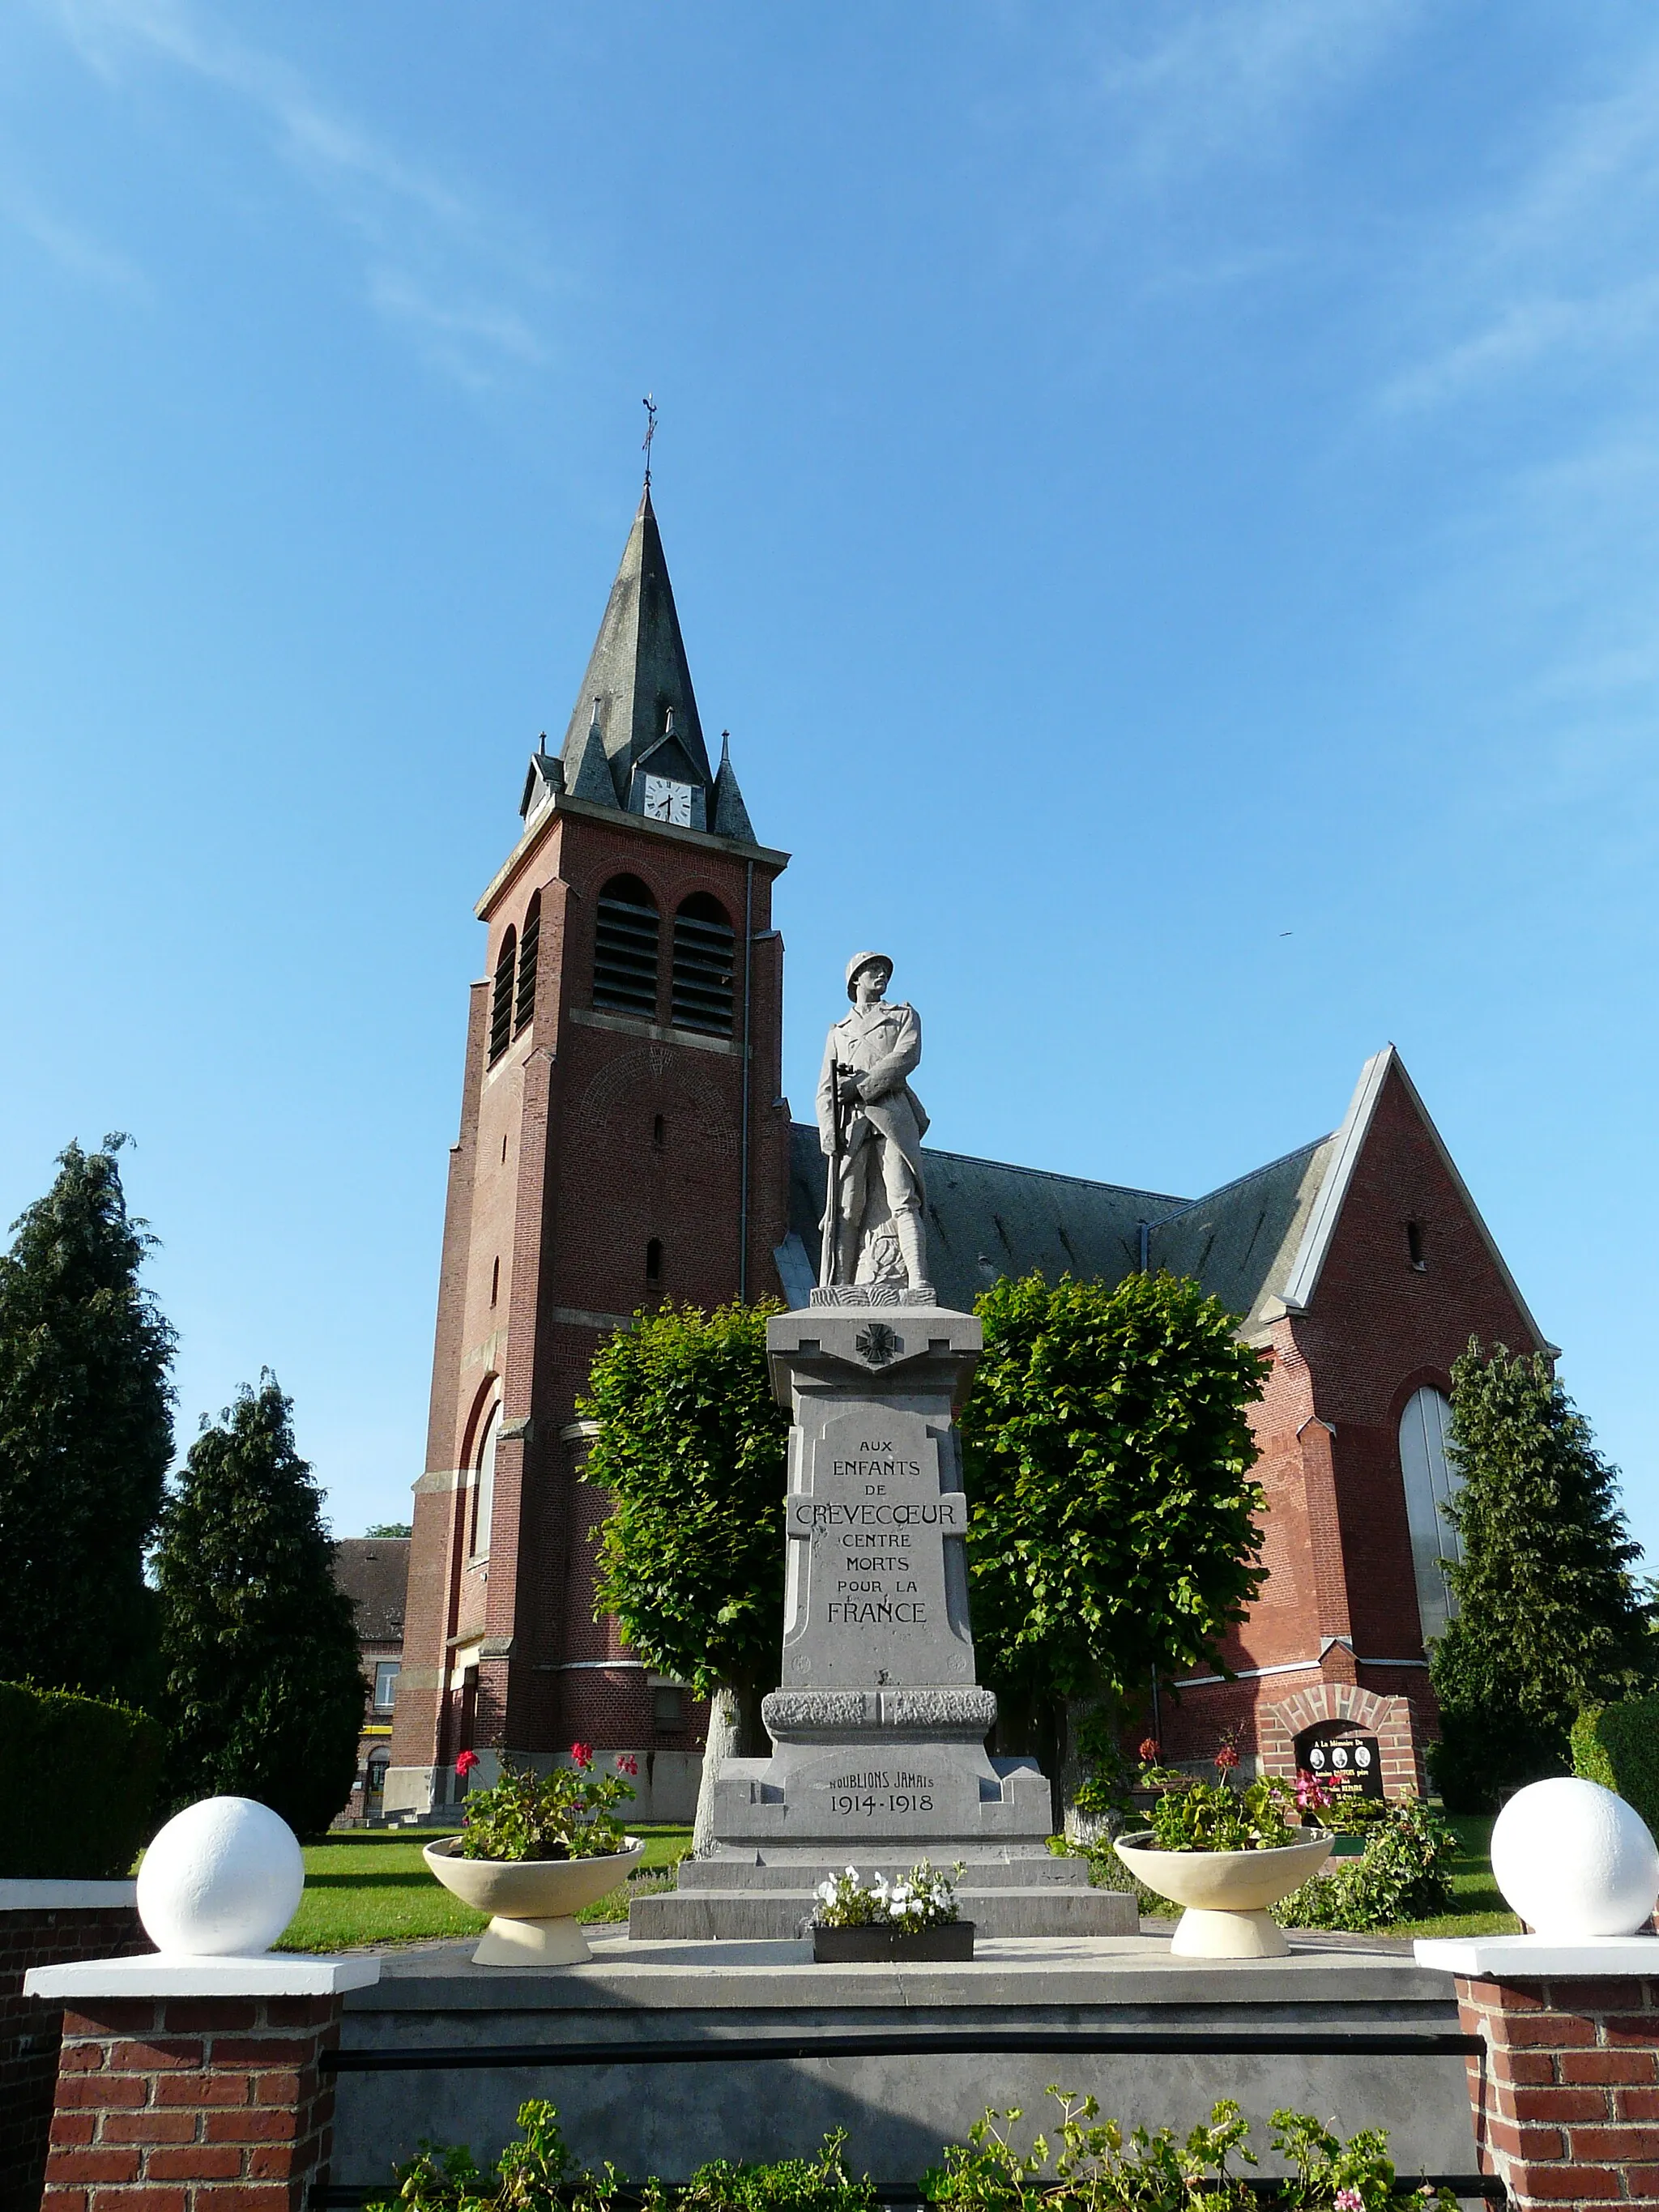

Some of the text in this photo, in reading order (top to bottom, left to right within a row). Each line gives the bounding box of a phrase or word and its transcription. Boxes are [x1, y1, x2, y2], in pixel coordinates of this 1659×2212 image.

[859, 1441, 893, 1451] AUX
[833, 1460, 920, 1476] ENFANTS
[864, 1485, 886, 1495] DE
[842, 1534, 911, 1547] CENTRE
[846, 1557, 910, 1571] MORTS
[838, 1580, 918, 1592] POUR LA
[827, 1602, 928, 1623] FRANCE
[831, 1794, 934, 1817] 1914-1918
